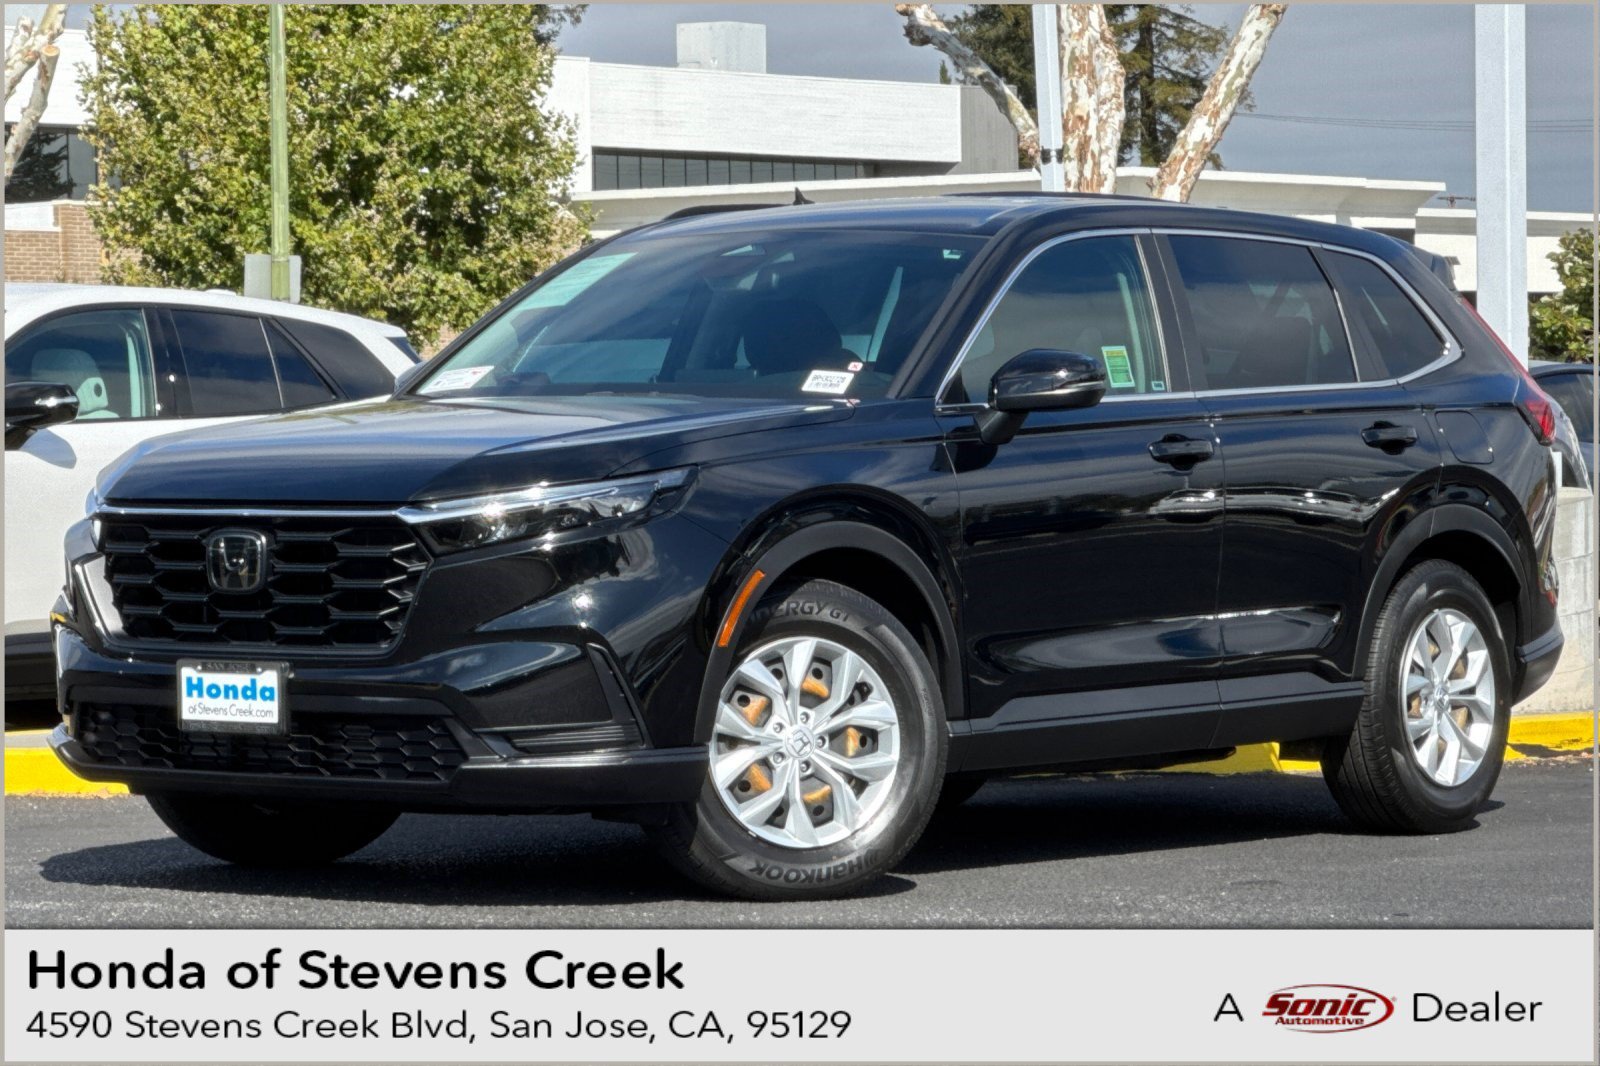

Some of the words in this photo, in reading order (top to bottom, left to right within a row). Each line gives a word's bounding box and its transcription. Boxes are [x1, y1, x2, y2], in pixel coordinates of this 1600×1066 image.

[186, 676, 275, 702] Honda
[188, 703, 197, 715] of
[197, 702, 228, 717] Stevens
[229, 704, 274, 718] Creek.com
